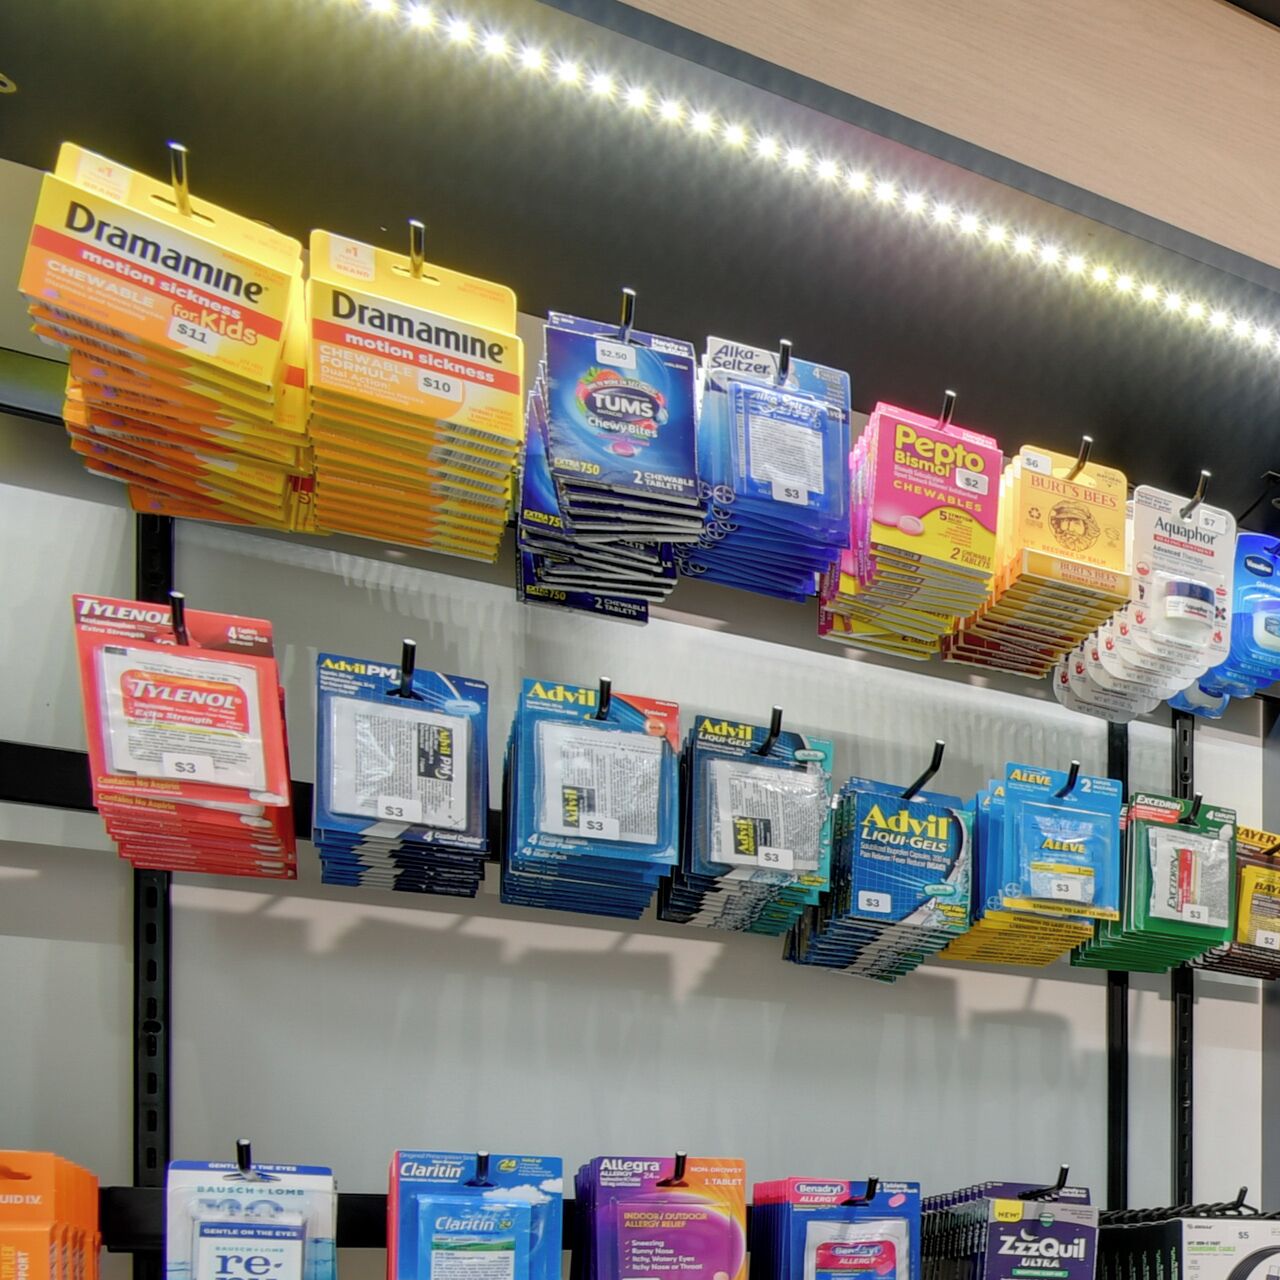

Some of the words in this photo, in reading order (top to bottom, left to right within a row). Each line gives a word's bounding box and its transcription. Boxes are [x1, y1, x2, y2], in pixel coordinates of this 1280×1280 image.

[65, 201, 264, 303] Dramamine
[47, 260, 155, 308] CHEWABLE
[81, 249, 155, 286] motion
[159, 280, 241, 319] sickness
[177, 323, 208, 344] $11
[198, 310, 258, 345] Kids
[332, 290, 504, 364] Dramamine
[345, 333, 414, 360] motion
[418, 352, 495, 383] sickness
[600, 349, 628, 361] $2.50
[713, 344, 760, 361] Alka-
[319, 345, 413, 377] CHEWABLE
[711, 356, 770, 375] Seltzer
[319, 355, 400, 385] FORMULA
[423, 377, 451, 393] $10
[592, 393, 654, 418] TUMS
[894, 424, 984, 474] Pepto
[554, 457, 581, 469] EXTRA
[581, 462, 601, 475] 750
[894, 450, 950, 478] Bismol
[1026, 457, 1039, 468] $6
[633, 470, 644, 485] 2
[644, 472, 695, 487] CHEWABLE
[645, 479, 684, 492] TABLETS
[964, 476, 980, 489] $2
[784, 488, 800, 499] $3
[893, 480, 984, 512] CHEWABLES
[1031, 475, 1080, 497] BURT'S
[1084, 490, 1118, 508] BEES
[1154, 517, 1217, 546] Aquaphor
[950, 547, 961, 560] 2
[960, 554, 991, 570] TABLETS
[550, 590, 567, 601] 750
[77, 598, 173, 626] TYLENOL
[594, 597, 604, 609] 2
[604, 599, 647, 612] CHEWABLE
[604, 604, 638, 616] TABLETS
[228, 626, 237, 640] 4
[322, 658, 366, 674] Advil
[366, 664, 398, 681] PM
[129, 679, 237, 710] TYLENOL
[528, 682, 595, 707] Advil
[166, 711, 213, 726] Strength
[699, 719, 753, 740] Advil
[439, 728, 452, 755] Advil
[175, 761, 196, 775] $3
[1010, 769, 1052, 786] ALEVE
[1081, 778, 1092, 793] 2
[564, 788, 580, 826] Advil
[1137, 794, 1181, 811] EXCEDRIN
[385, 806, 403, 818] $3
[1206, 810, 1214, 820] 4
[587, 821, 604, 832] $3
[861, 804, 948, 840] Advil
[423, 831, 434, 842] 4
[529, 833, 538, 845] 4
[736, 817, 750, 854] Advil
[1042, 839, 1086, 855] ALEVE
[764, 853, 779, 863] $3
[1056, 884, 1069, 893] $3
[1168, 856, 1179, 910] EXCEDRIN
[866, 898, 880, 908] $3
[926, 897, 937, 910] 4
[1190, 910, 1201, 919] $3
[1264, 936, 1275, 946] $2
[400, 1162, 462, 1178] Claritin
[600, 1159, 660, 1174] Allegra
[197, 1186, 254, 1194] BAUSCH
[268, 1188, 305, 1196] LOMB
[800, 1184, 842, 1195] Benadryl
[435, 1215, 495, 1231] Claritin
[203, 1228, 239, 1236] GENTLE
[1238, 1231, 1249, 1240] $5
[998, 1236, 1086, 1261] ZzzQuil
[1021, 1258, 1060, 1268] ULTRA
